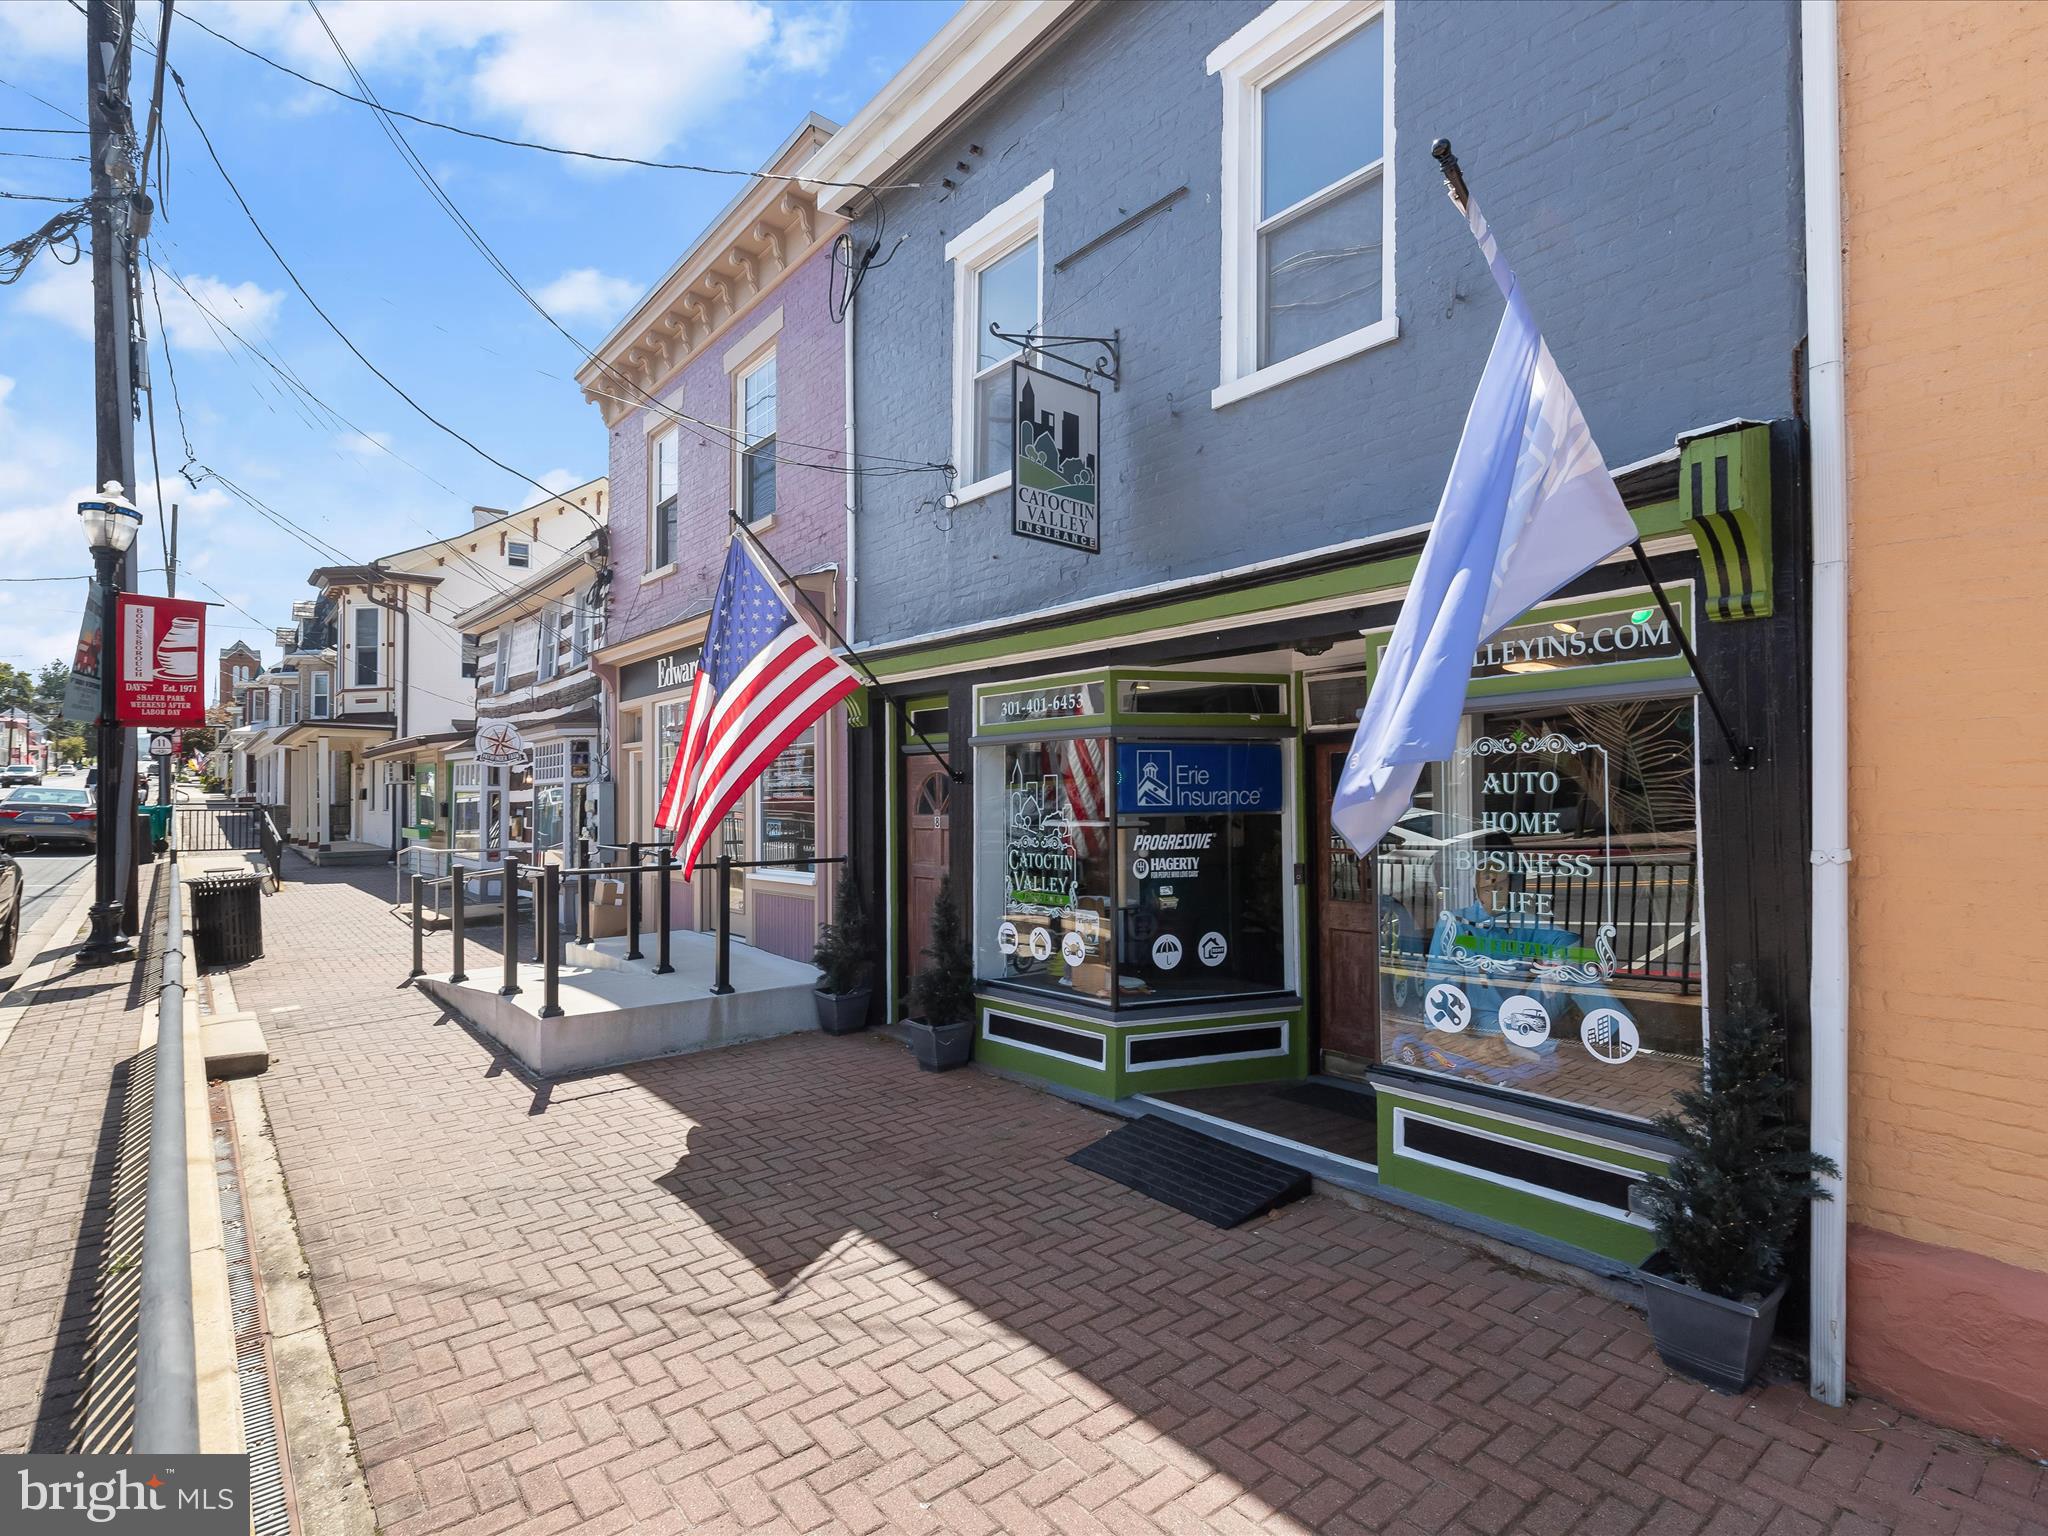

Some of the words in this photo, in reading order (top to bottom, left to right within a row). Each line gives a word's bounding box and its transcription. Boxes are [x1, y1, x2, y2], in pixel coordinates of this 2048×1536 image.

[1019, 487, 1095, 520] CATOCTIN
[1027, 505, 1089, 534] VALLEY
[1018, 520, 1096, 547] INSURANCE
[1472, 619, 1672, 668] LLEYINS.COM
[125, 683, 148, 691] DAYS
[162, 684, 177, 692] Est.
[1001, 693, 1083, 716] 301-401-6453
[1176, 765, 1210, 785] Erie
[1481, 771, 1560, 795] AUTO
[1176, 786, 1261, 806] Insurance
[1481, 811, 1561, 834] HOME
[1133, 833, 1213, 851] PROGRESSIVE
[1008, 849, 1073, 870] CATOCTIN
[1150, 857, 1200, 871] HAGERTY
[1455, 850, 1593, 877] BUSINESS
[1013, 871, 1068, 894] VALLEY
[1491, 890, 1554, 915] LIFE
